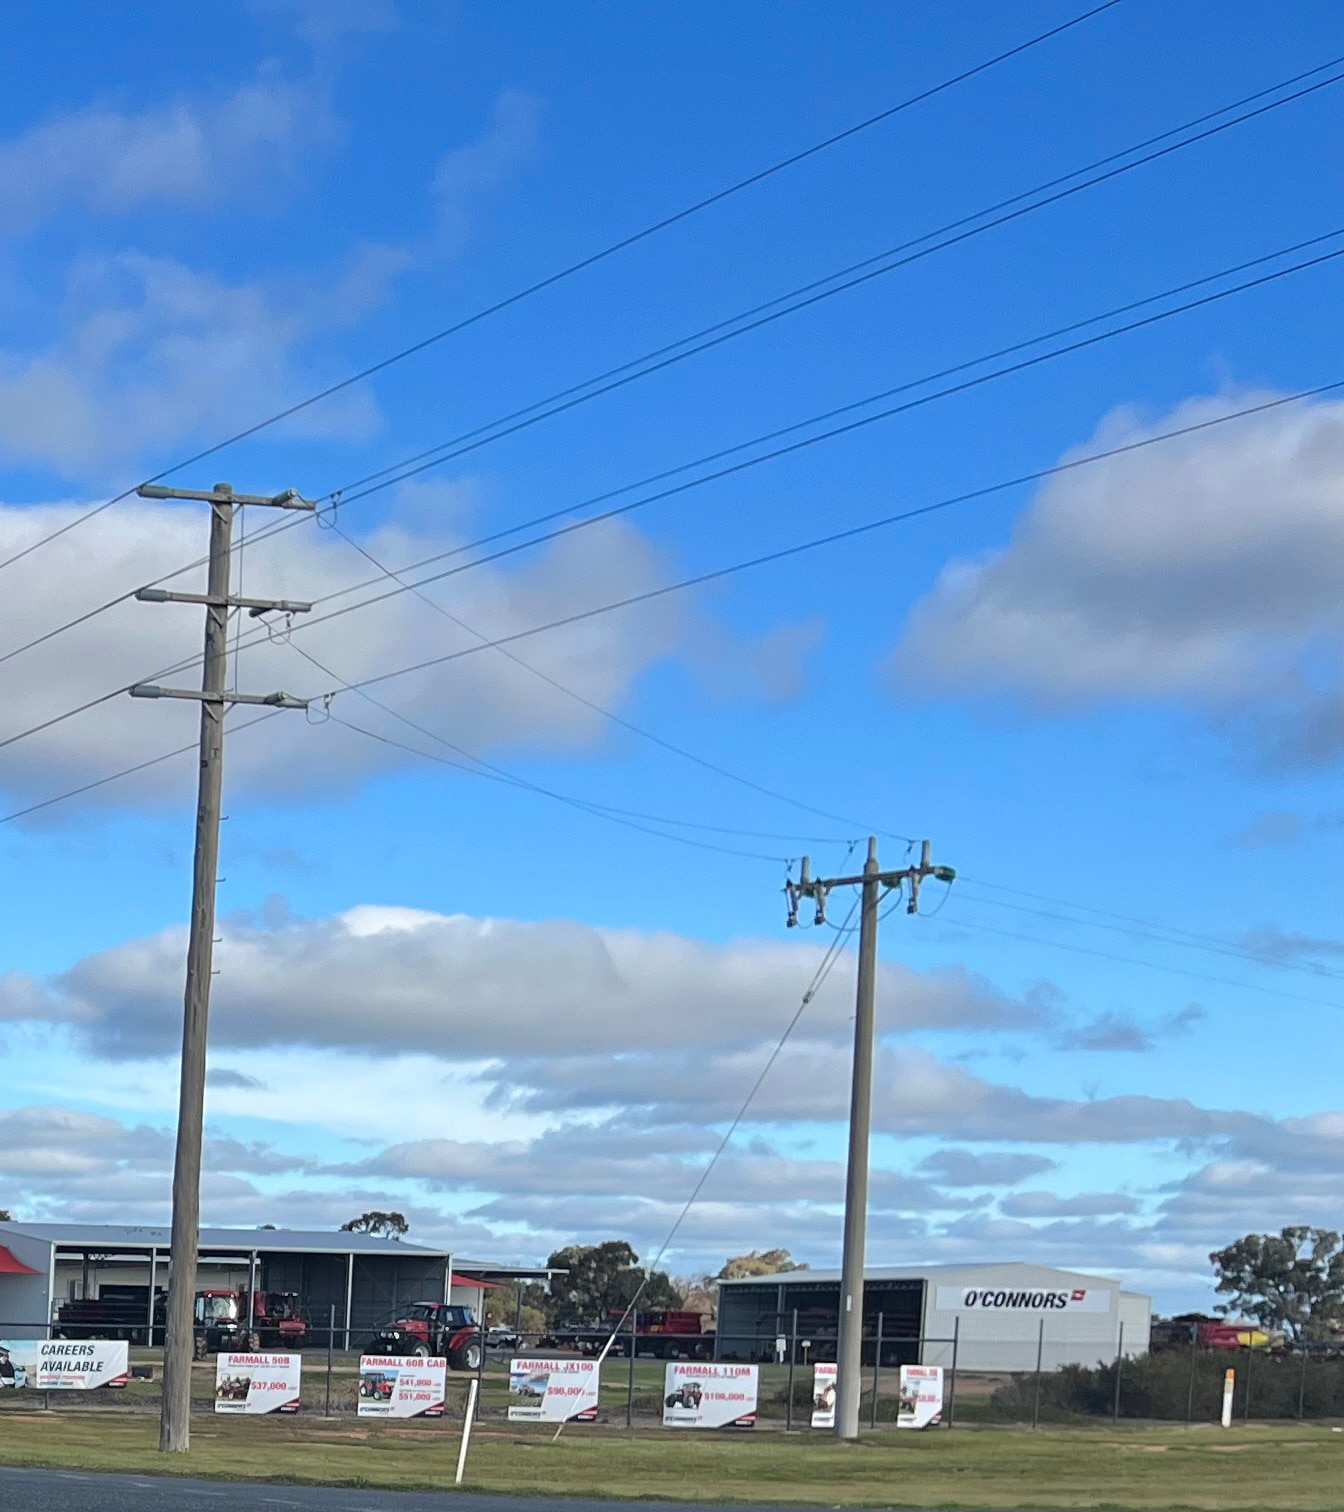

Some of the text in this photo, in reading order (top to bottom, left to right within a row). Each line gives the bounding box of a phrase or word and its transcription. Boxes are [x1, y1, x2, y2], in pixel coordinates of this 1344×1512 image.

[964, 1290, 1069, 1309] O'CONNORS
[40, 1344, 95, 1356] CAREERS
[228, 1355, 269, 1364] FARMALL
[361, 1357, 403, 1367] FARMALL
[427, 1360, 446, 1368] CAB
[39, 1361, 104, 1372] AVAILABLE
[516, 1361, 560, 1370] FARMALL
[674, 1365, 751, 1376] FARMALL 110M
